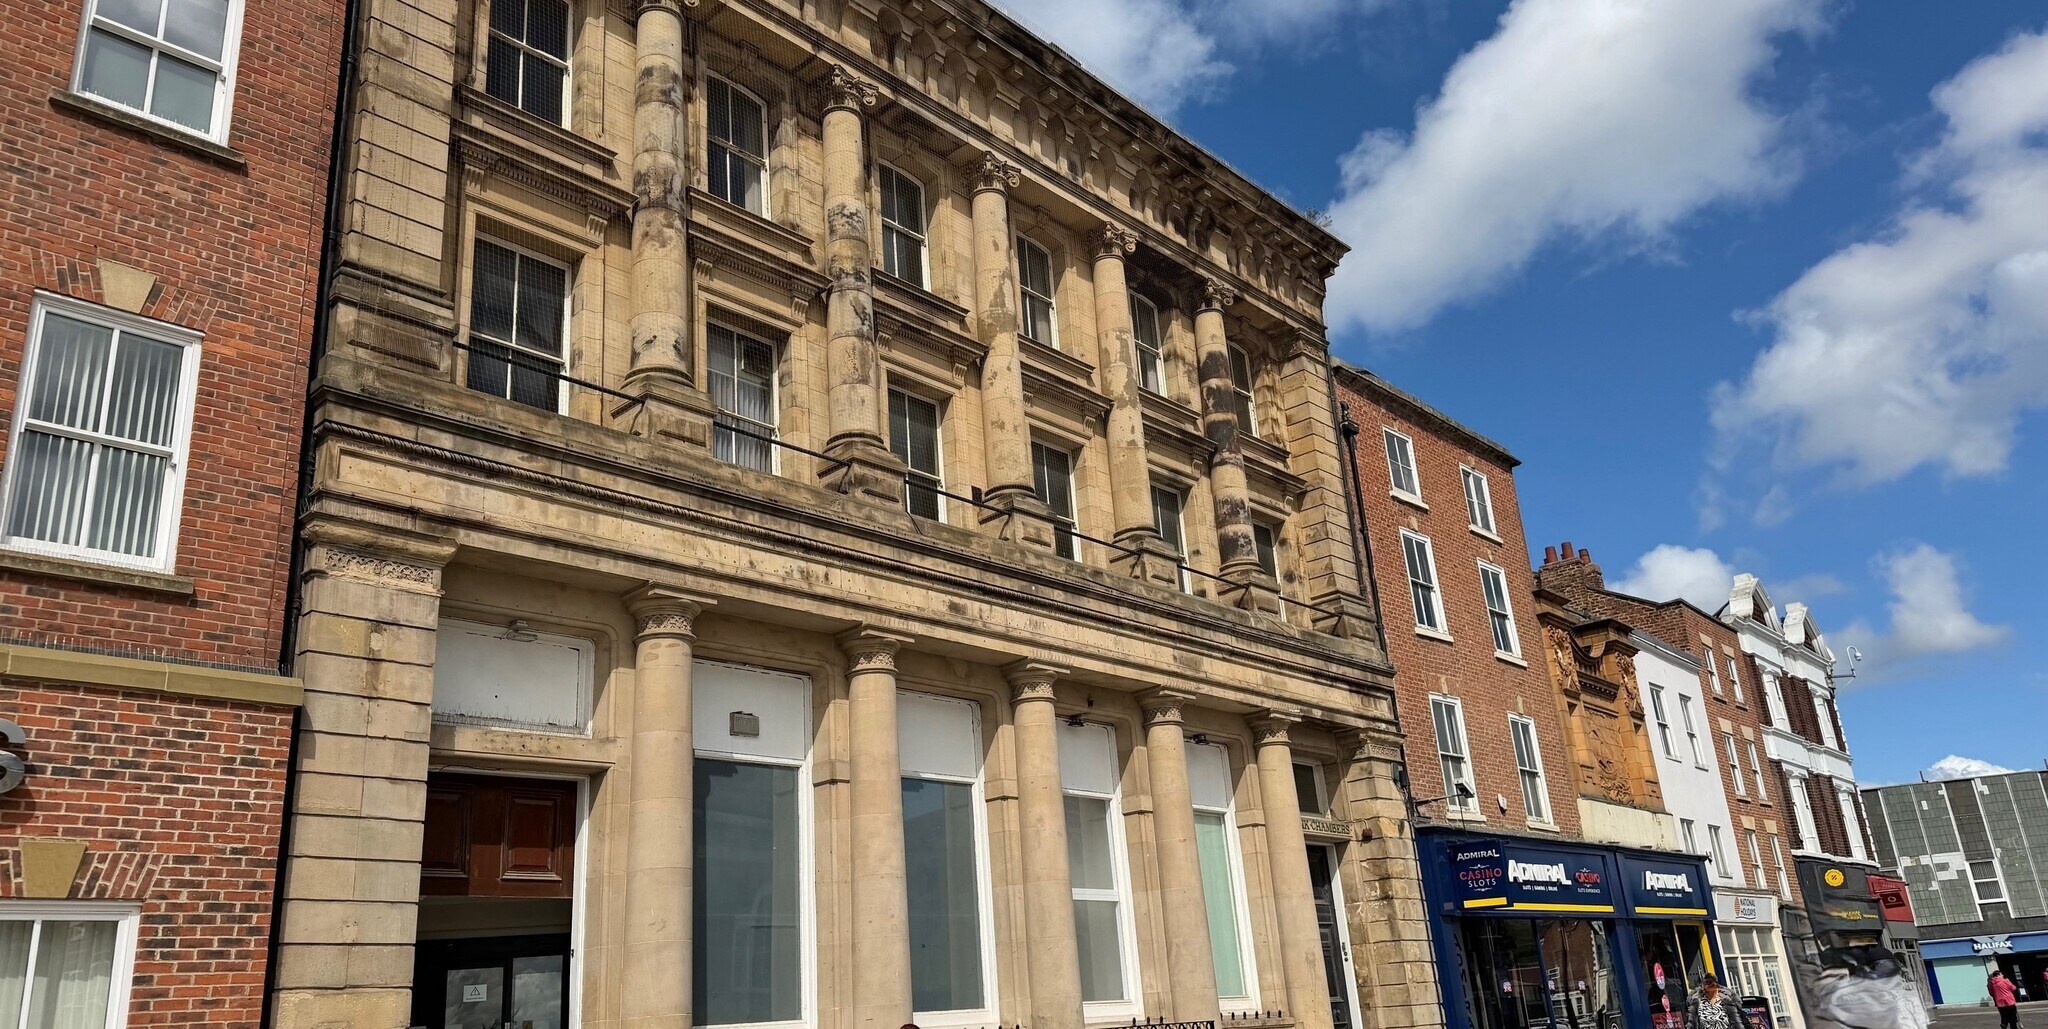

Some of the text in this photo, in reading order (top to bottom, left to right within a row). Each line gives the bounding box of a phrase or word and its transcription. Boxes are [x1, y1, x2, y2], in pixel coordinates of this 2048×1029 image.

[1457, 849, 1500, 861] ADMIRAL
[1459, 868, 1502, 880] CASINO
[1508, 859, 1572, 885] ADMIRAL
[1575, 872, 1600, 884] CASINO
[1468, 878, 1496, 888] SLOTS
[1645, 870, 1693, 893] ADMIRAL
[1973, 940, 2014, 951] HALIFAX
